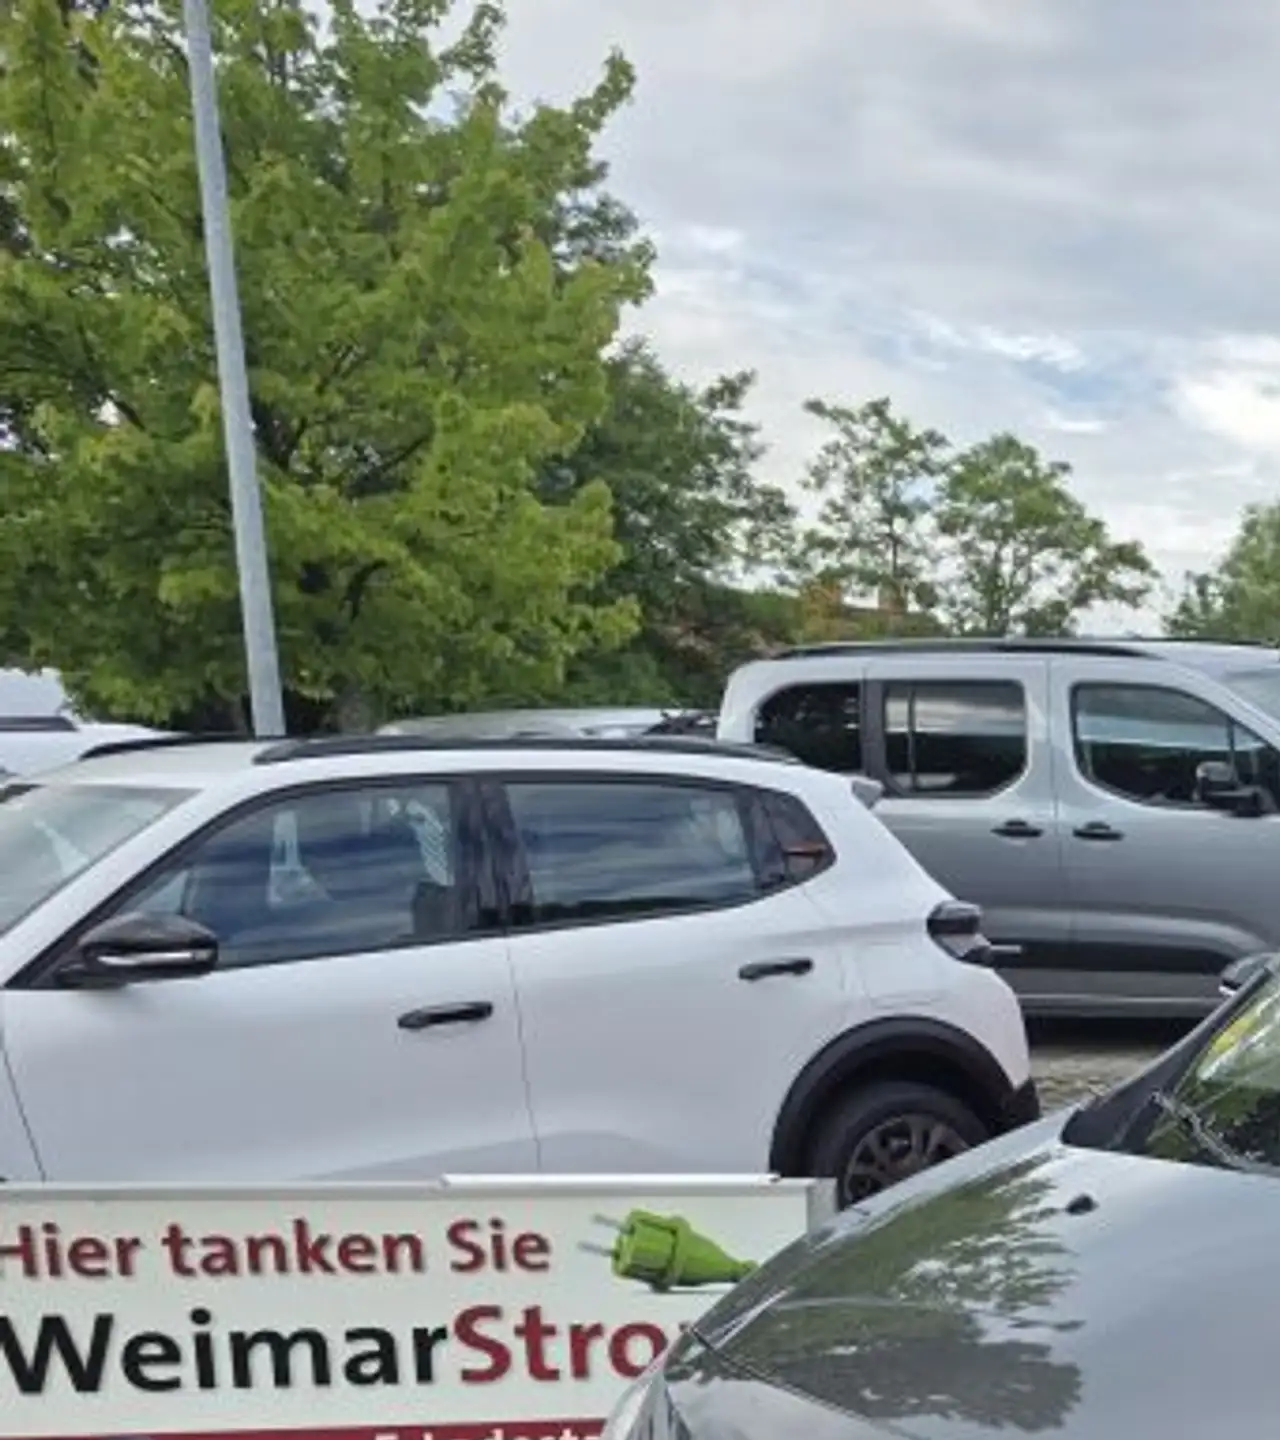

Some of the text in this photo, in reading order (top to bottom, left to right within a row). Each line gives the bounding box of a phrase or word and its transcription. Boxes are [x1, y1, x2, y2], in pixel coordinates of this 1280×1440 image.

[0, 1218, 552, 1277] Hier tanken Sie
[0, 1304, 692, 1394] WeimarStro
